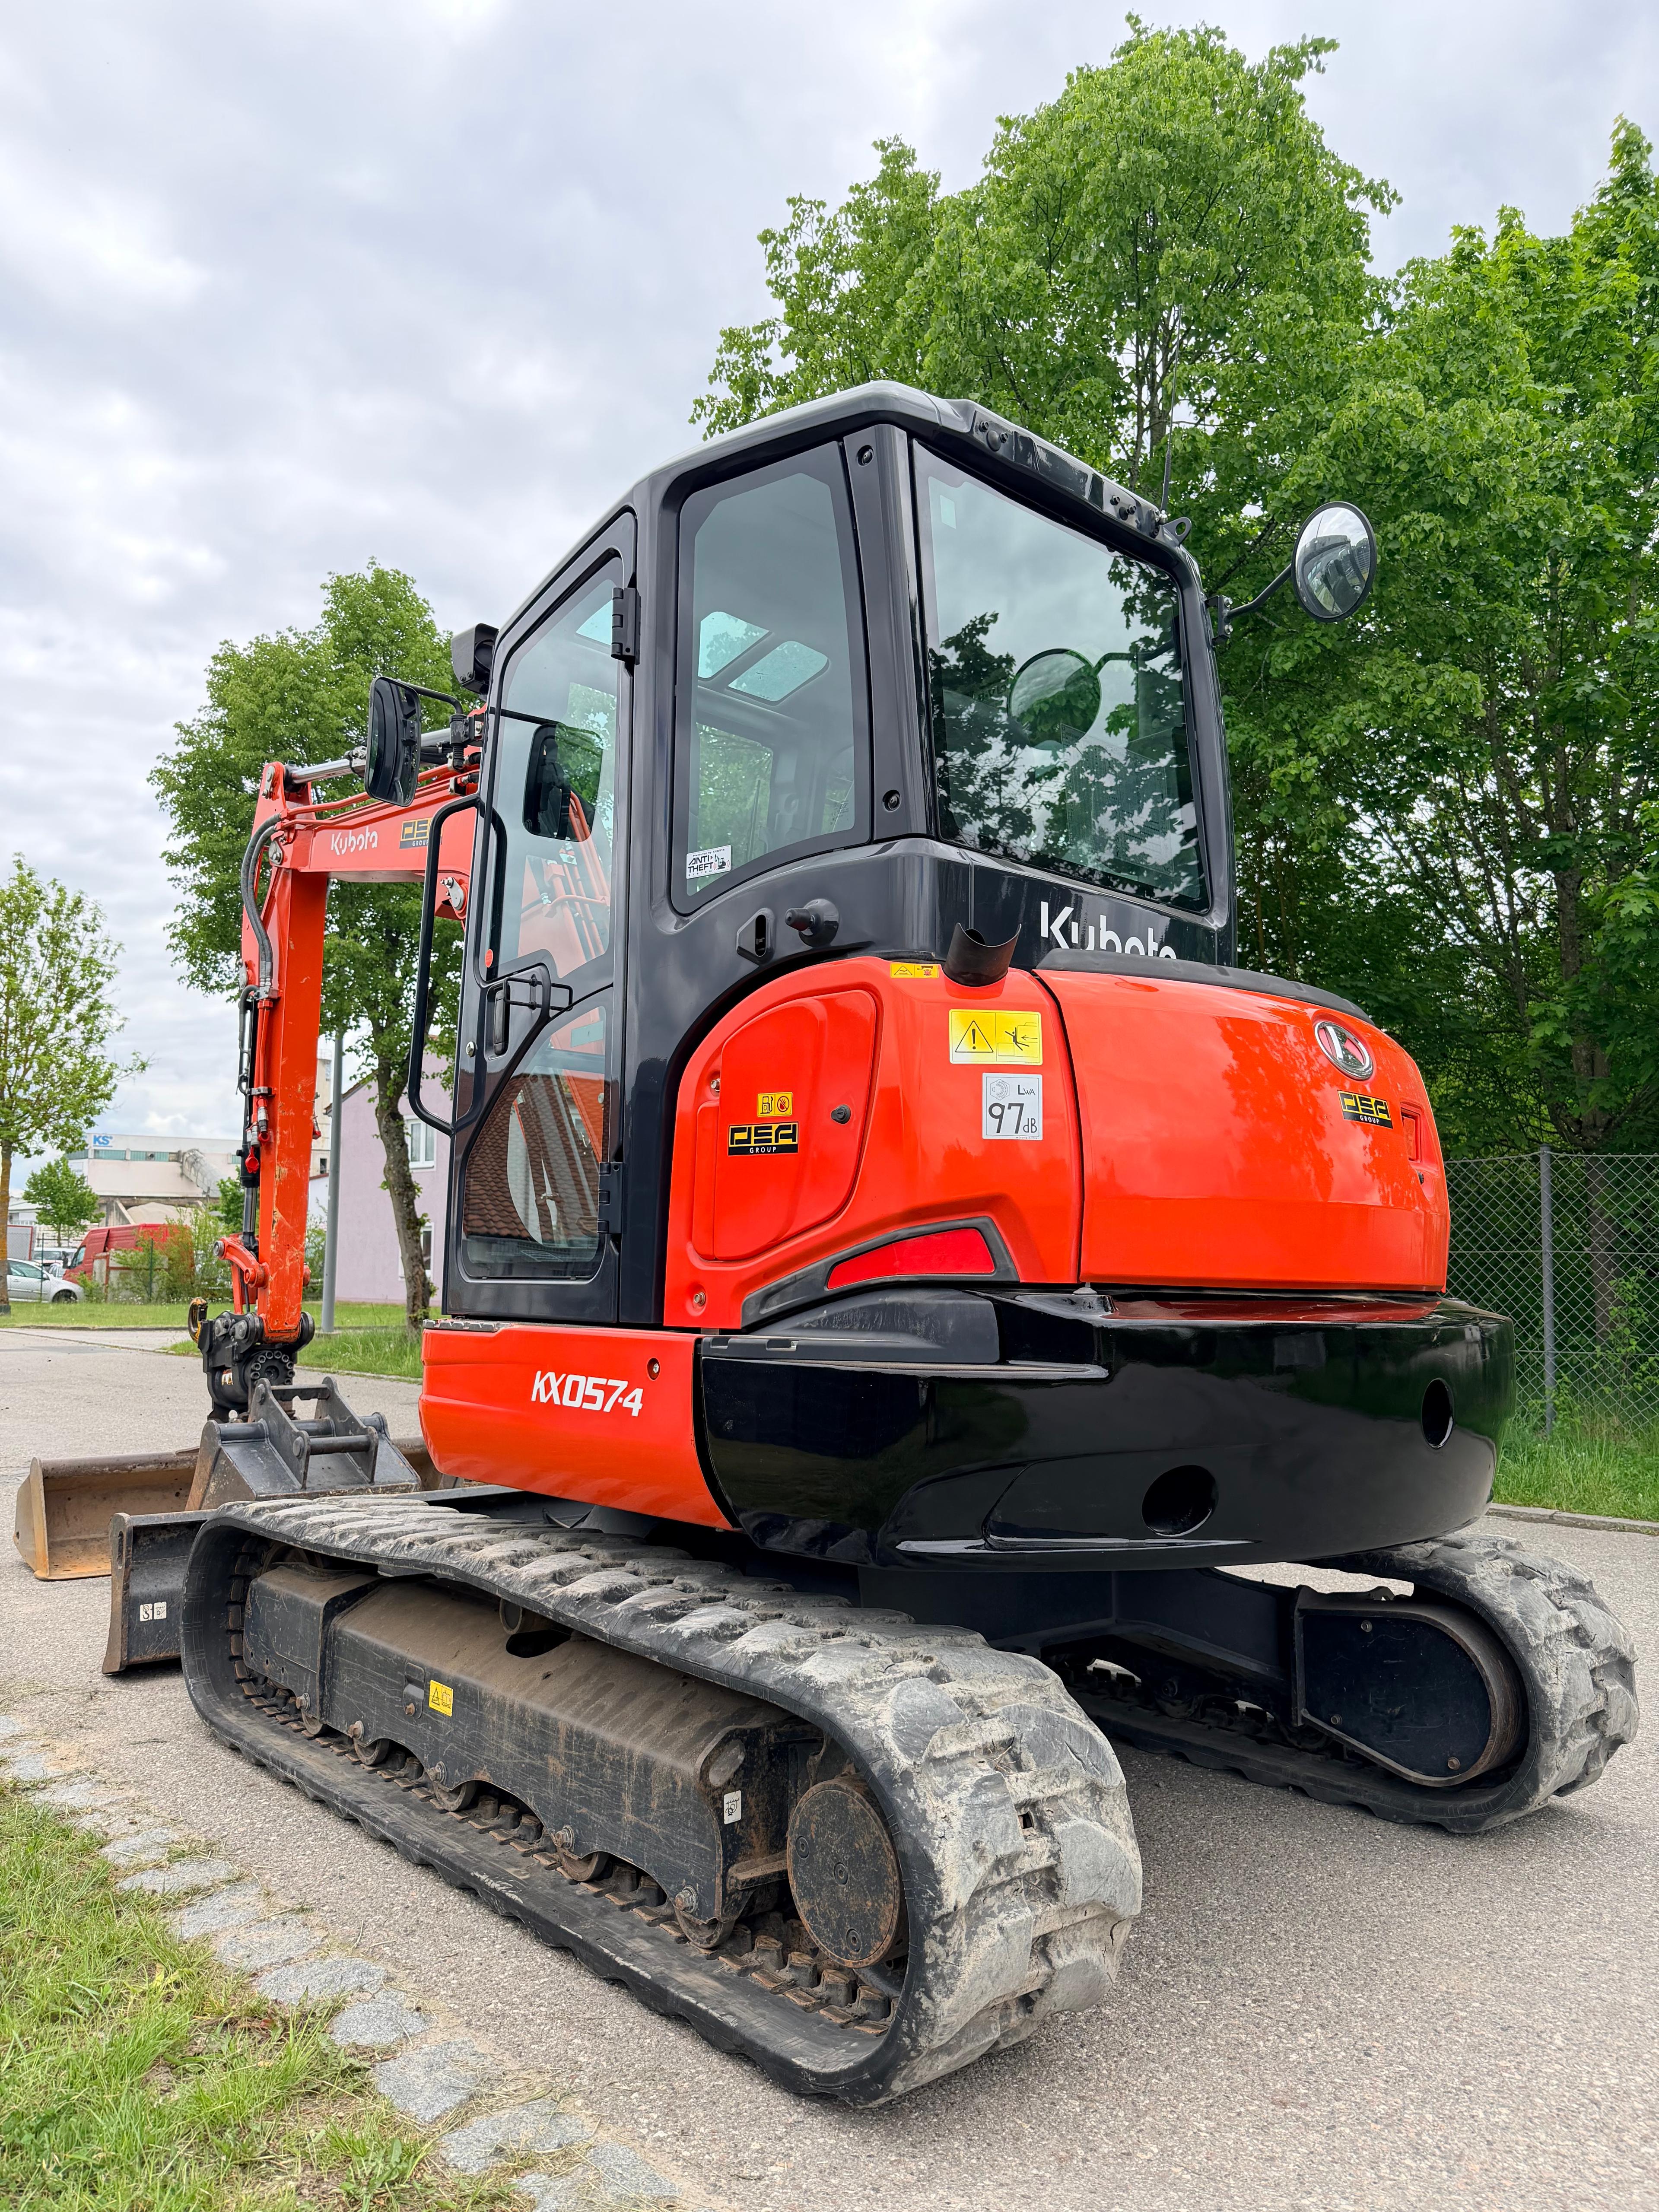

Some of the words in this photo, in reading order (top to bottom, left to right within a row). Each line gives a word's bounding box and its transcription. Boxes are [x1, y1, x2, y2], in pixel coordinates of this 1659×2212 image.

[331, 826, 378, 855] Kubota
[688, 855, 709, 865] ANTI
[688, 862, 713, 873] THEFT
[988, 1103, 1024, 1134] 97
[1023, 1118, 1037, 1133] dB
[1360, 1115, 1379, 1124] GROUP
